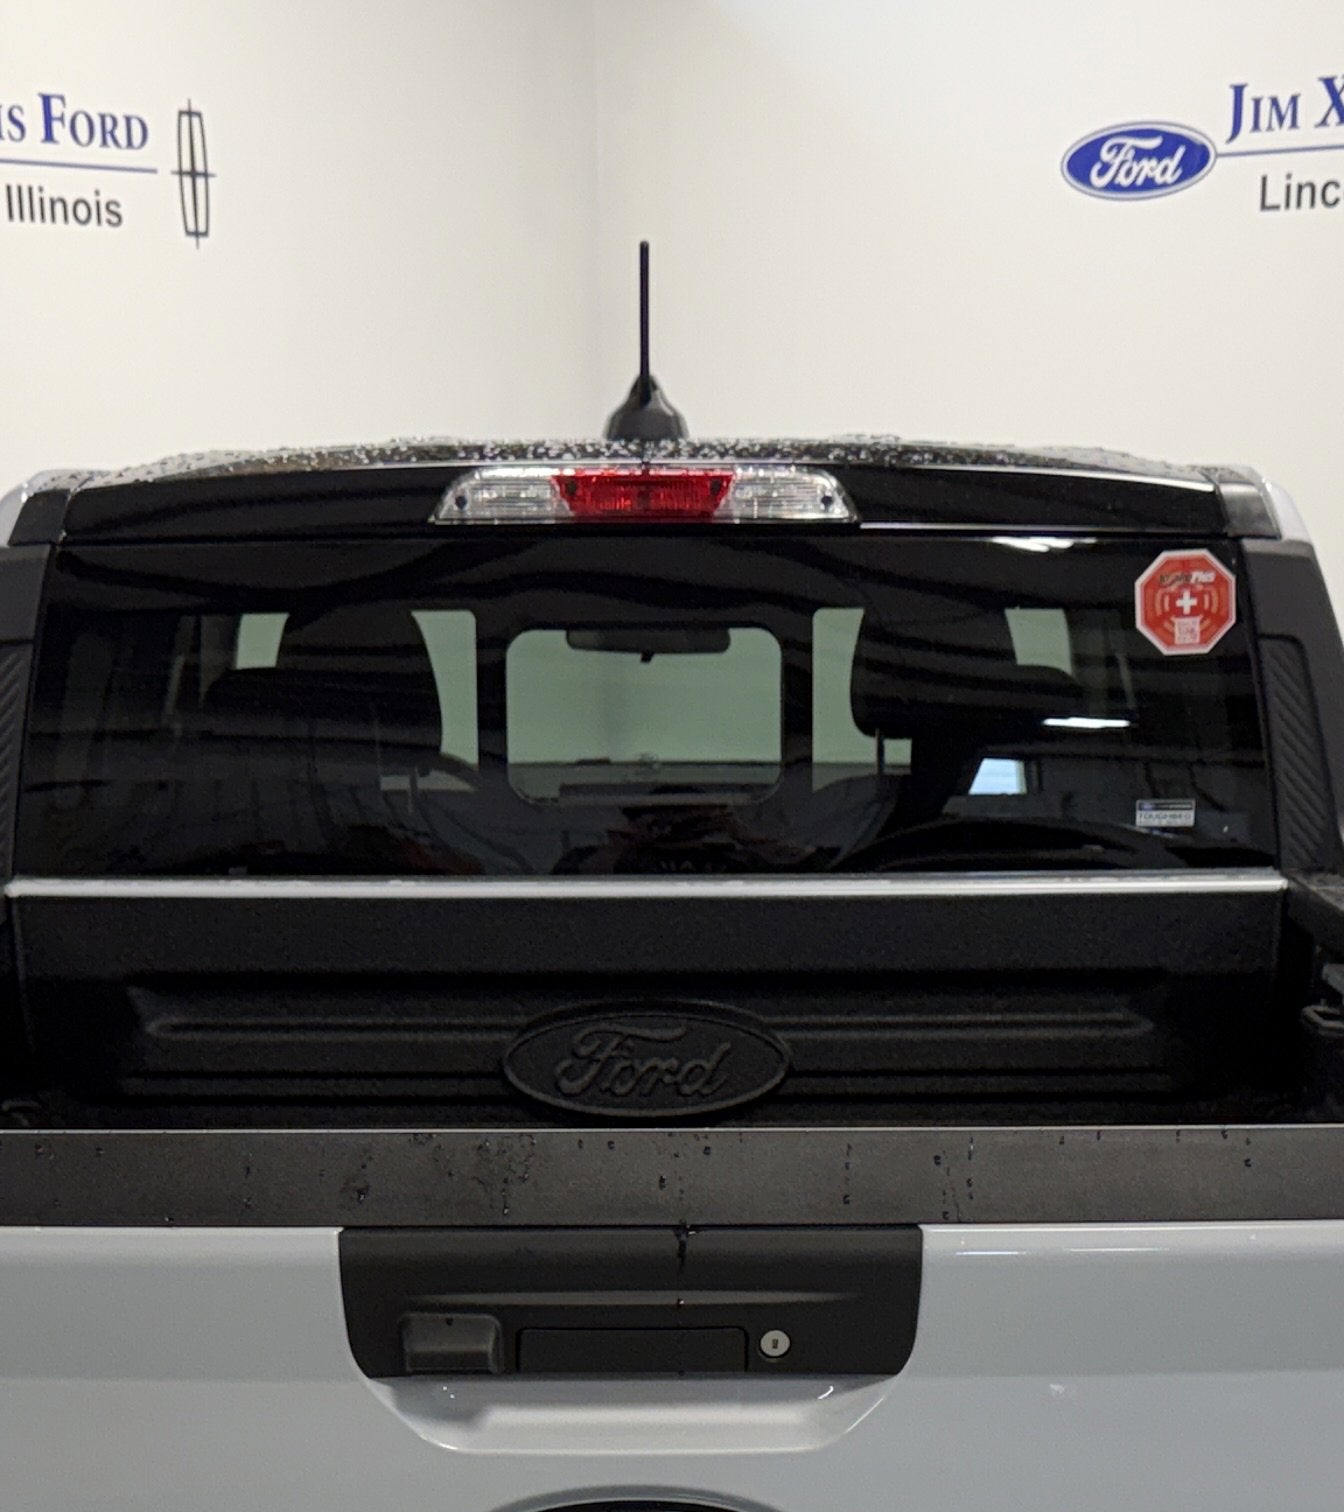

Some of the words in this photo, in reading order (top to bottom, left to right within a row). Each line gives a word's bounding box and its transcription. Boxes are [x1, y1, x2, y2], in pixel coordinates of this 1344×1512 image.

[37, 92, 149, 151] FORD
[1226, 82, 1301, 144] JIM
[1088, 136, 1185, 189] Ford
[5, 183, 124, 228] Illinois
[556, 1023, 732, 1097] Ford
